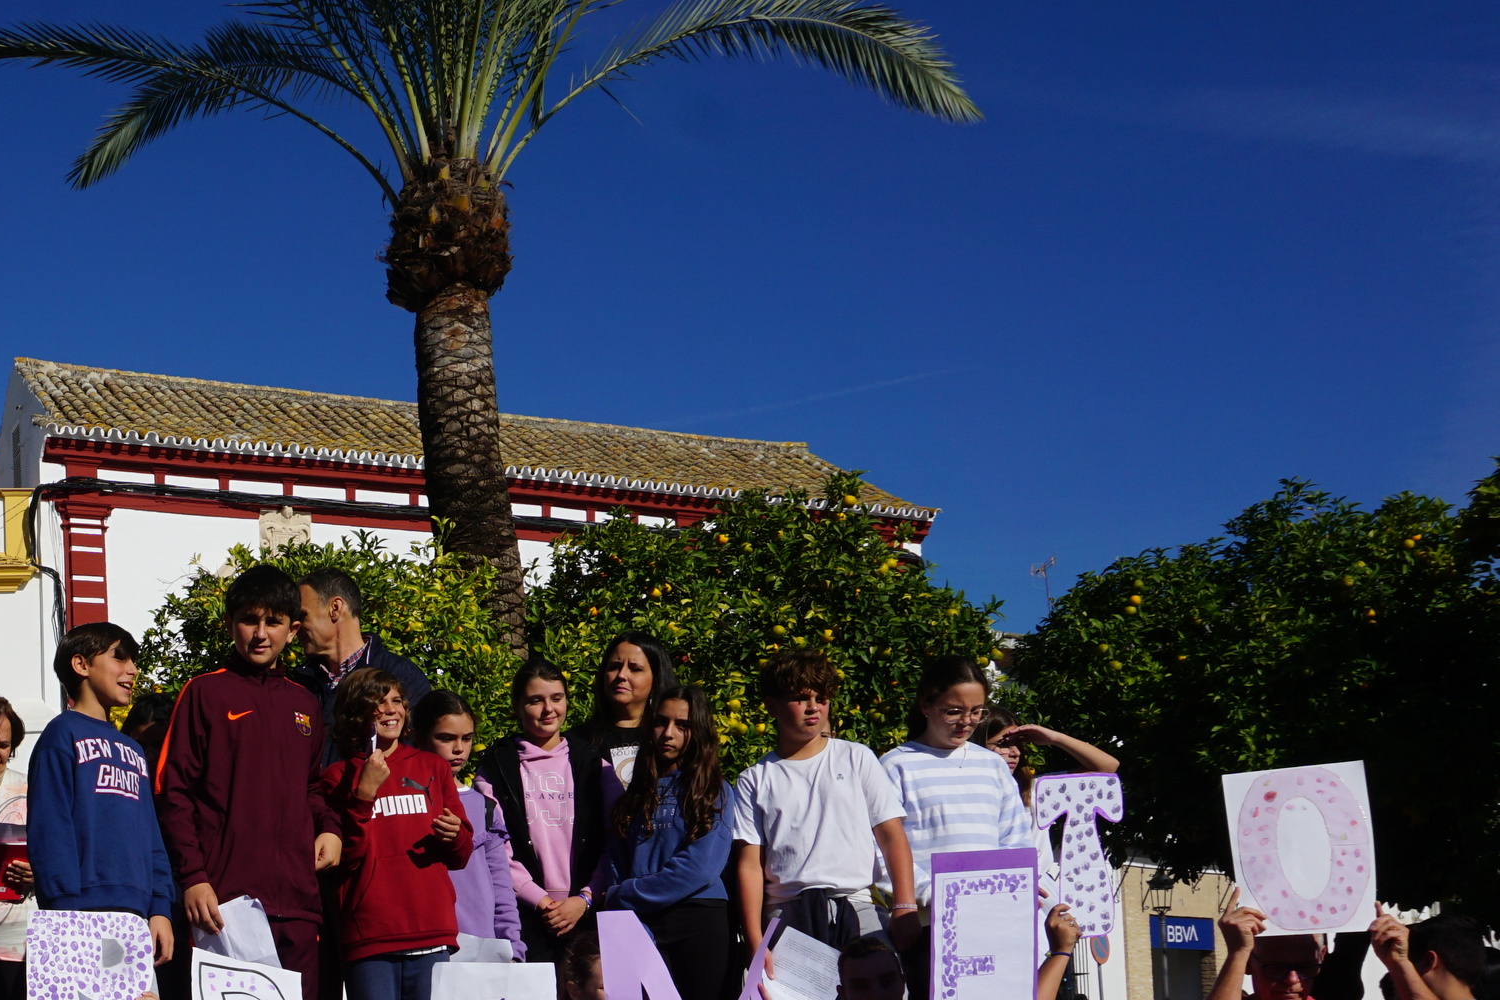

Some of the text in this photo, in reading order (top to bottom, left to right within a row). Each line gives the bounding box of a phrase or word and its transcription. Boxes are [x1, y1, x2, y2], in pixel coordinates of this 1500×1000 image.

[75, 738, 148, 778] NEW YORK
[97, 764, 140, 795] GIANTS
[371, 794, 428, 819] PUMA
[539, 792, 574, 801] ANGE
[1036, 773, 1124, 938] T
[1237, 767, 1373, 931] O
[1166, 924, 1199, 943] BBVA
